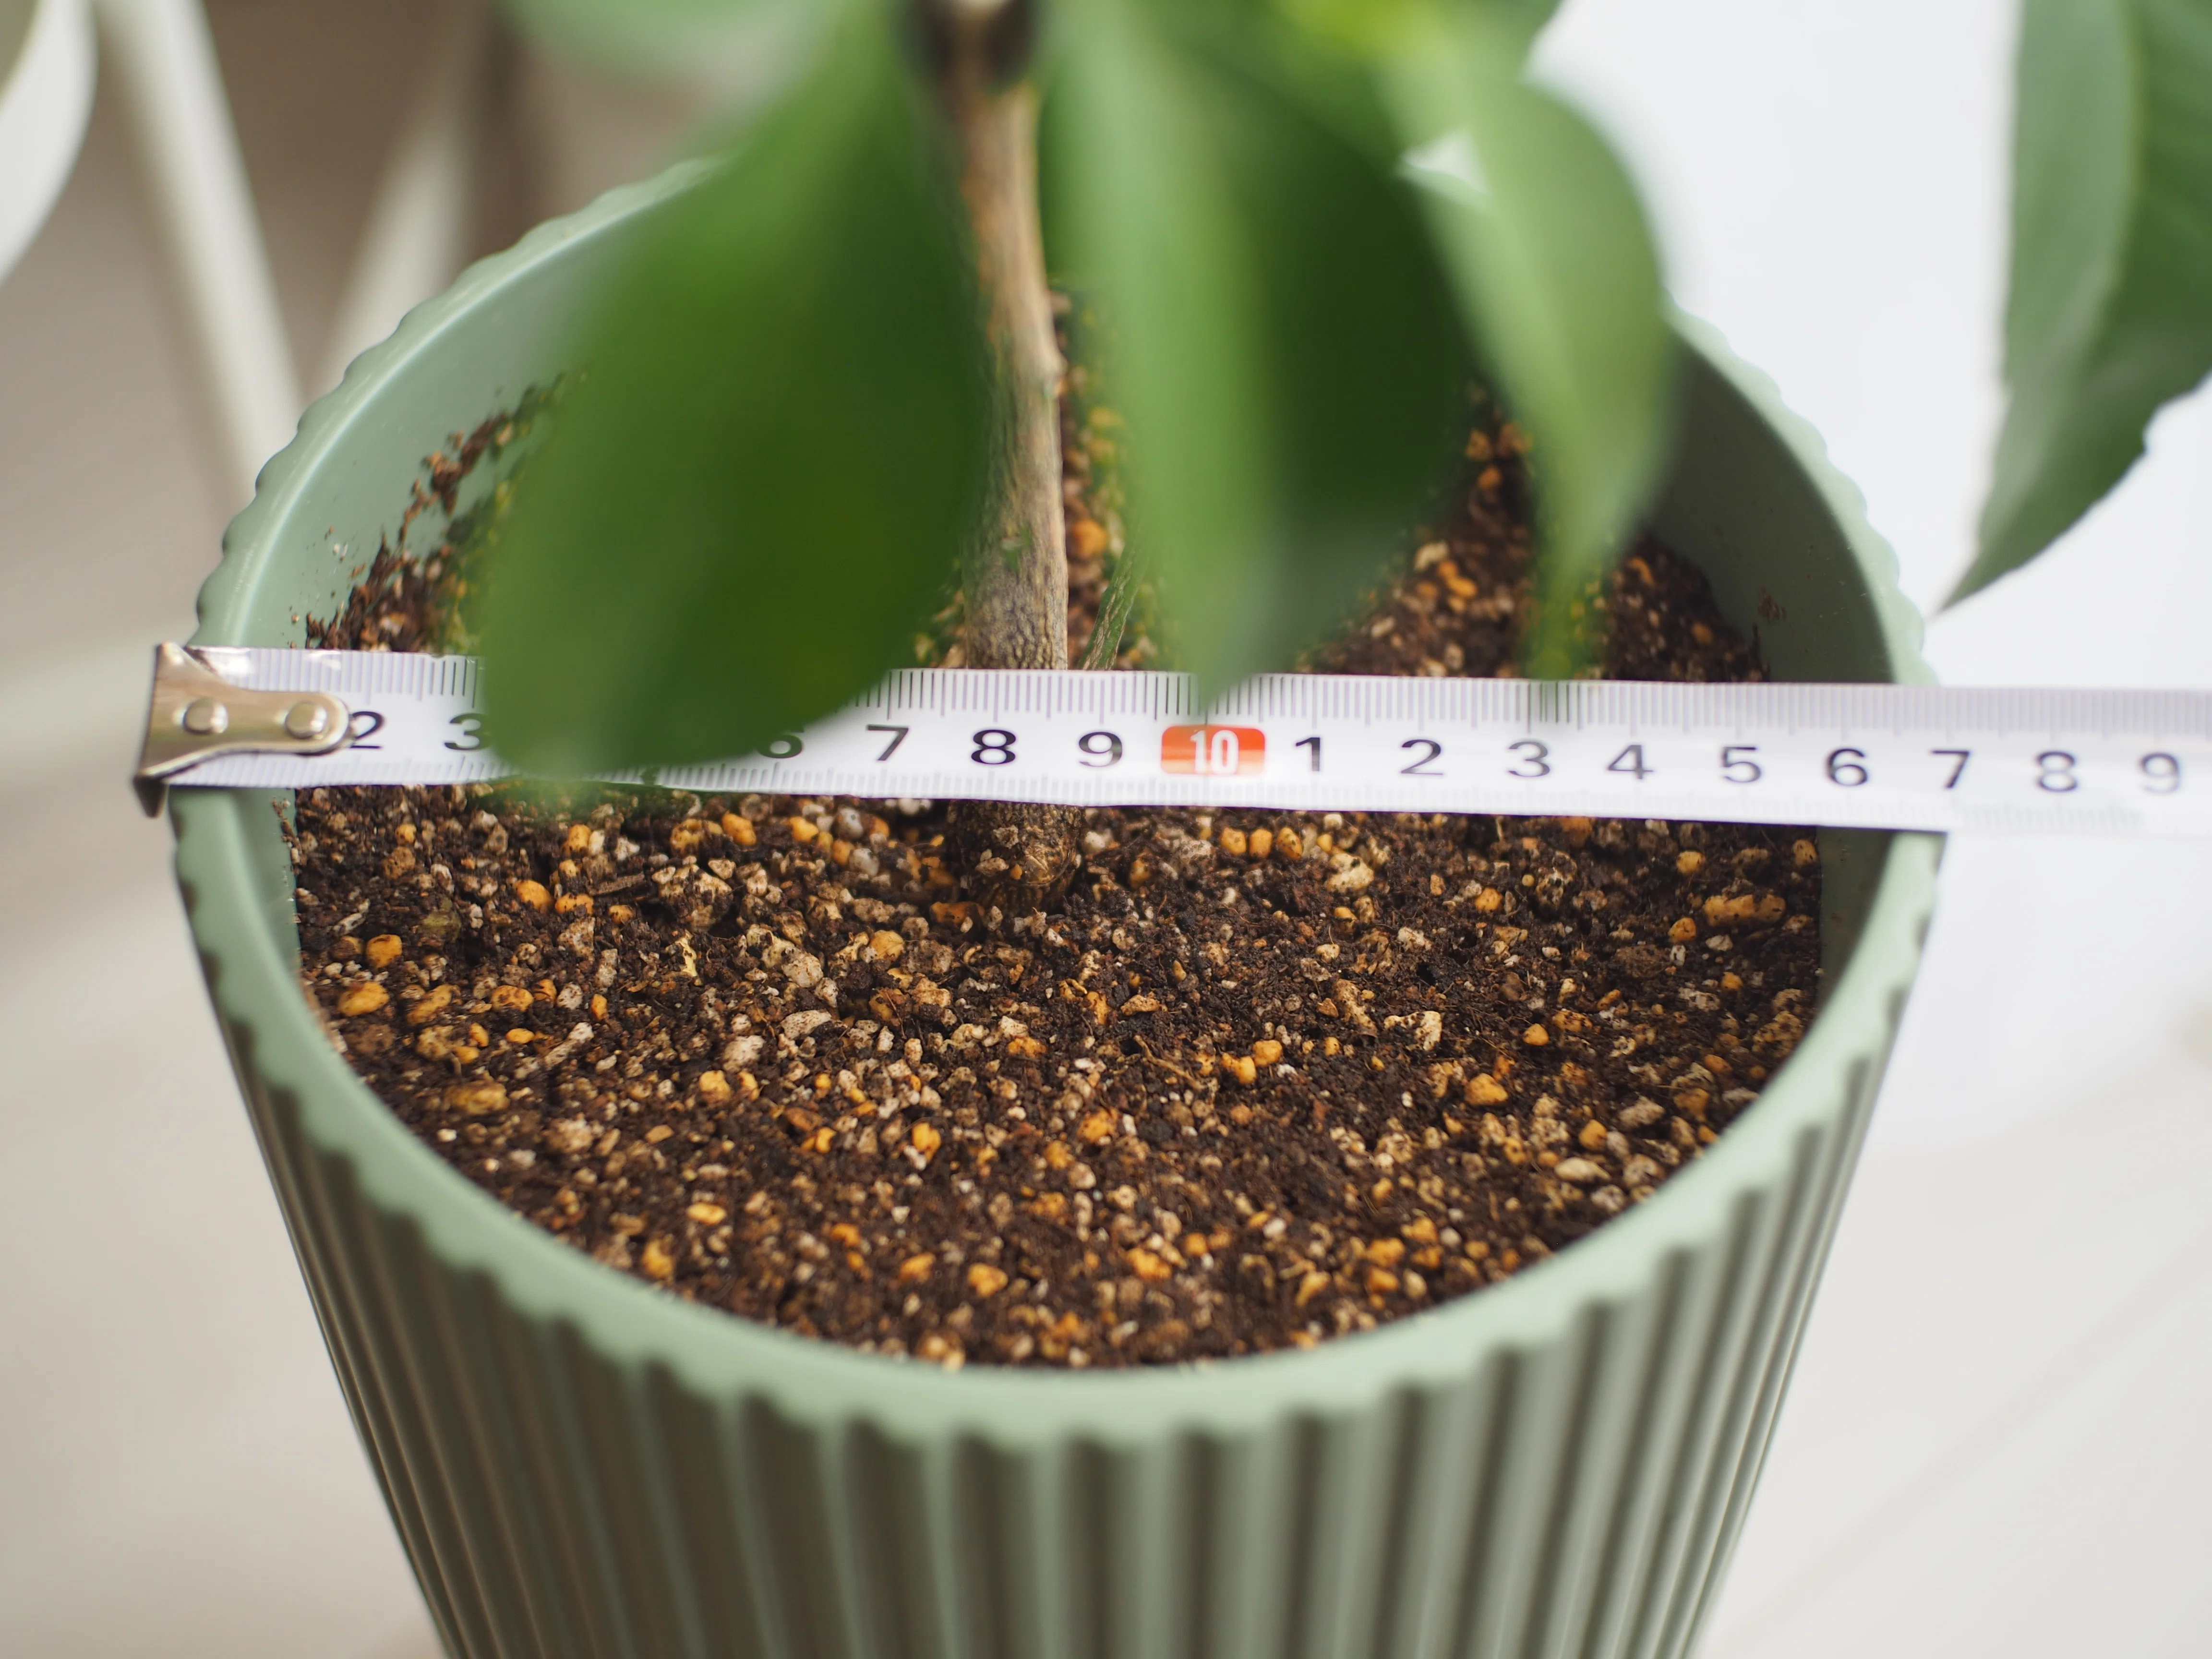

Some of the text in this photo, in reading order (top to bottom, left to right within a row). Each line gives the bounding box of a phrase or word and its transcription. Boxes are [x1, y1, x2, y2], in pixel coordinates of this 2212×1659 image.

[350, 711, 384, 749] 2
[444, 713, 490, 750] 3
[866, 724, 909, 761] 7
[971, 729, 1017, 765] 8
[1078, 731, 1123, 768] 9
[1190, 729, 1239, 775] 10
[1294, 736, 1321, 772] 1
[1399, 739, 1444, 775] 2
[1507, 740, 1551, 778] 3
[1606, 744, 1655, 780] 4
[1721, 746, 1761, 783] 5
[1826, 747, 1869, 787] 6
[1929, 749, 1972, 789] 7
[2034, 750, 2078, 792] 8
[2138, 752, 2182, 794] 9
